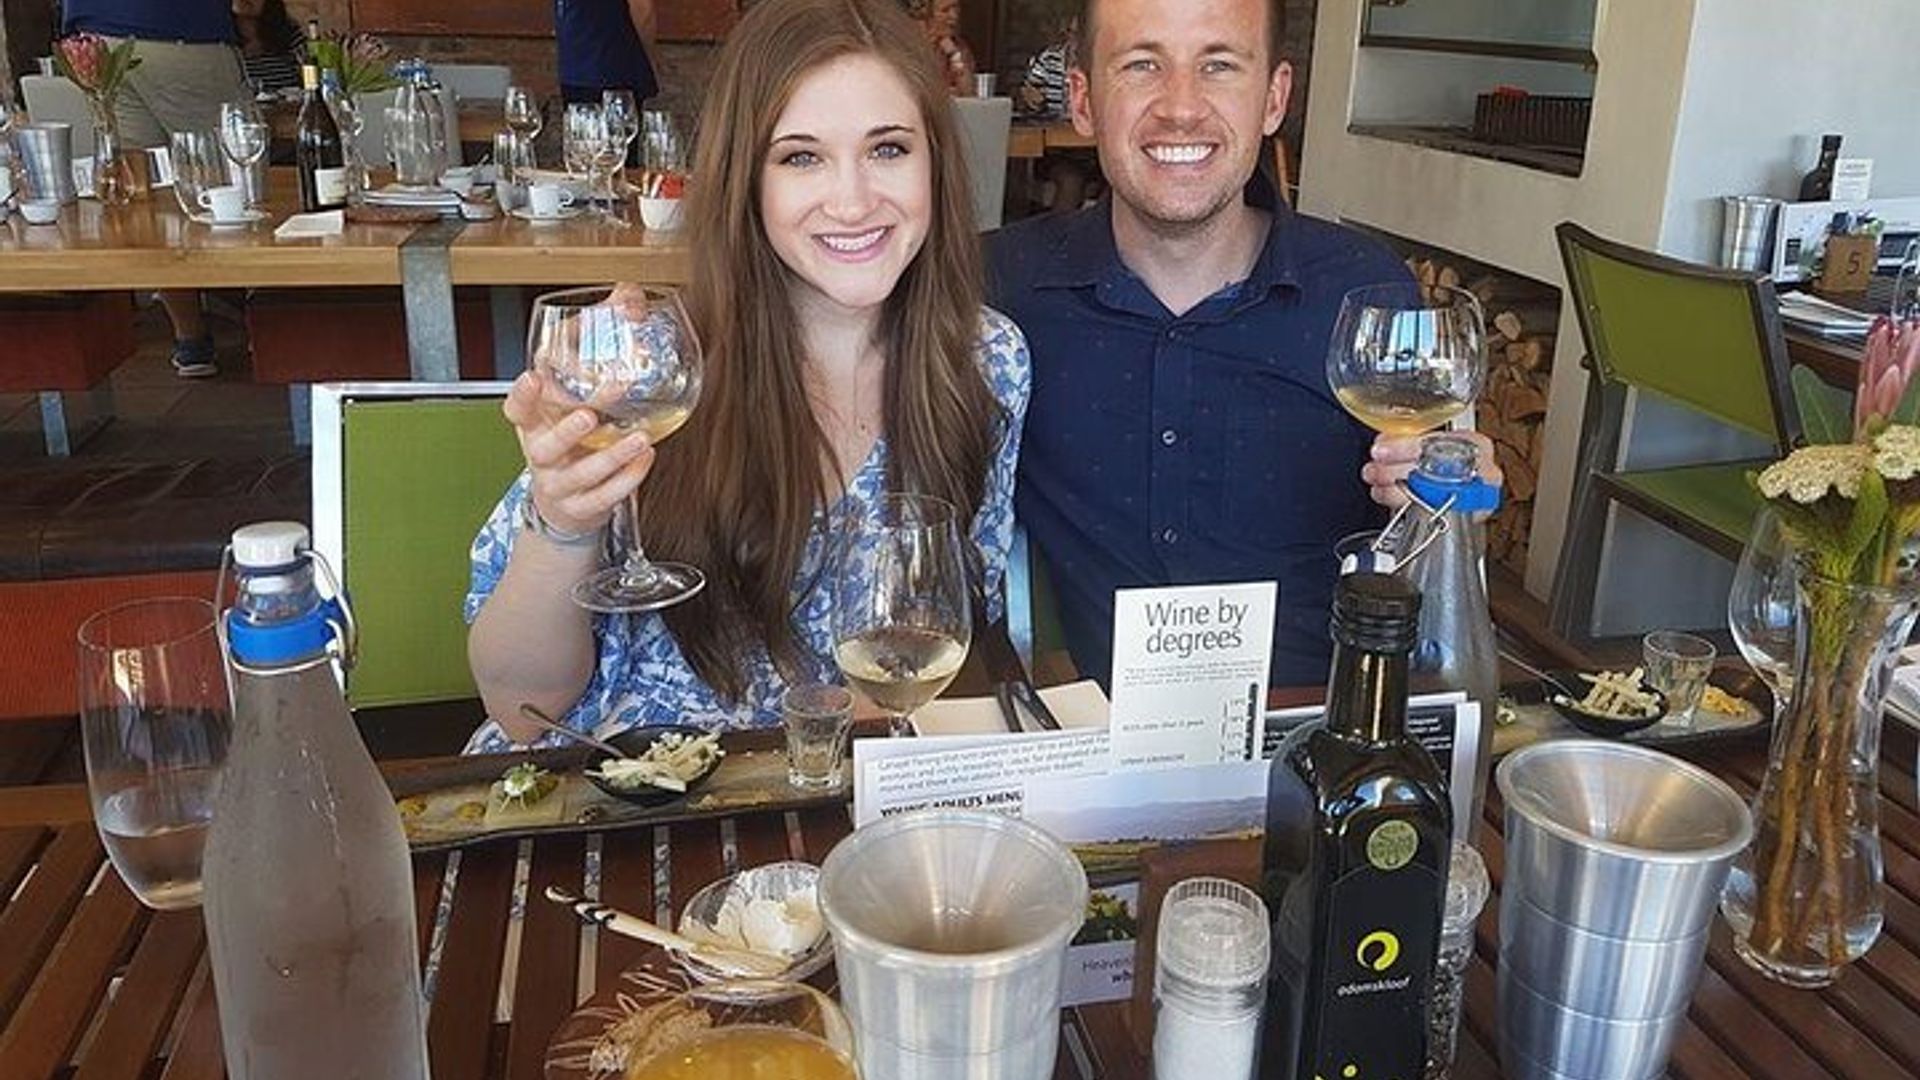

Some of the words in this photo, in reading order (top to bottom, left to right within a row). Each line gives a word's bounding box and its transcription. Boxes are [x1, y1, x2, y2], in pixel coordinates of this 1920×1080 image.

[1848, 251, 1861, 276] 5
[1145, 599, 1210, 627] Wine
[1217, 596, 1250, 629] by
[1146, 628, 1243, 659] degrees
[932, 796, 983, 808] ADULTS
